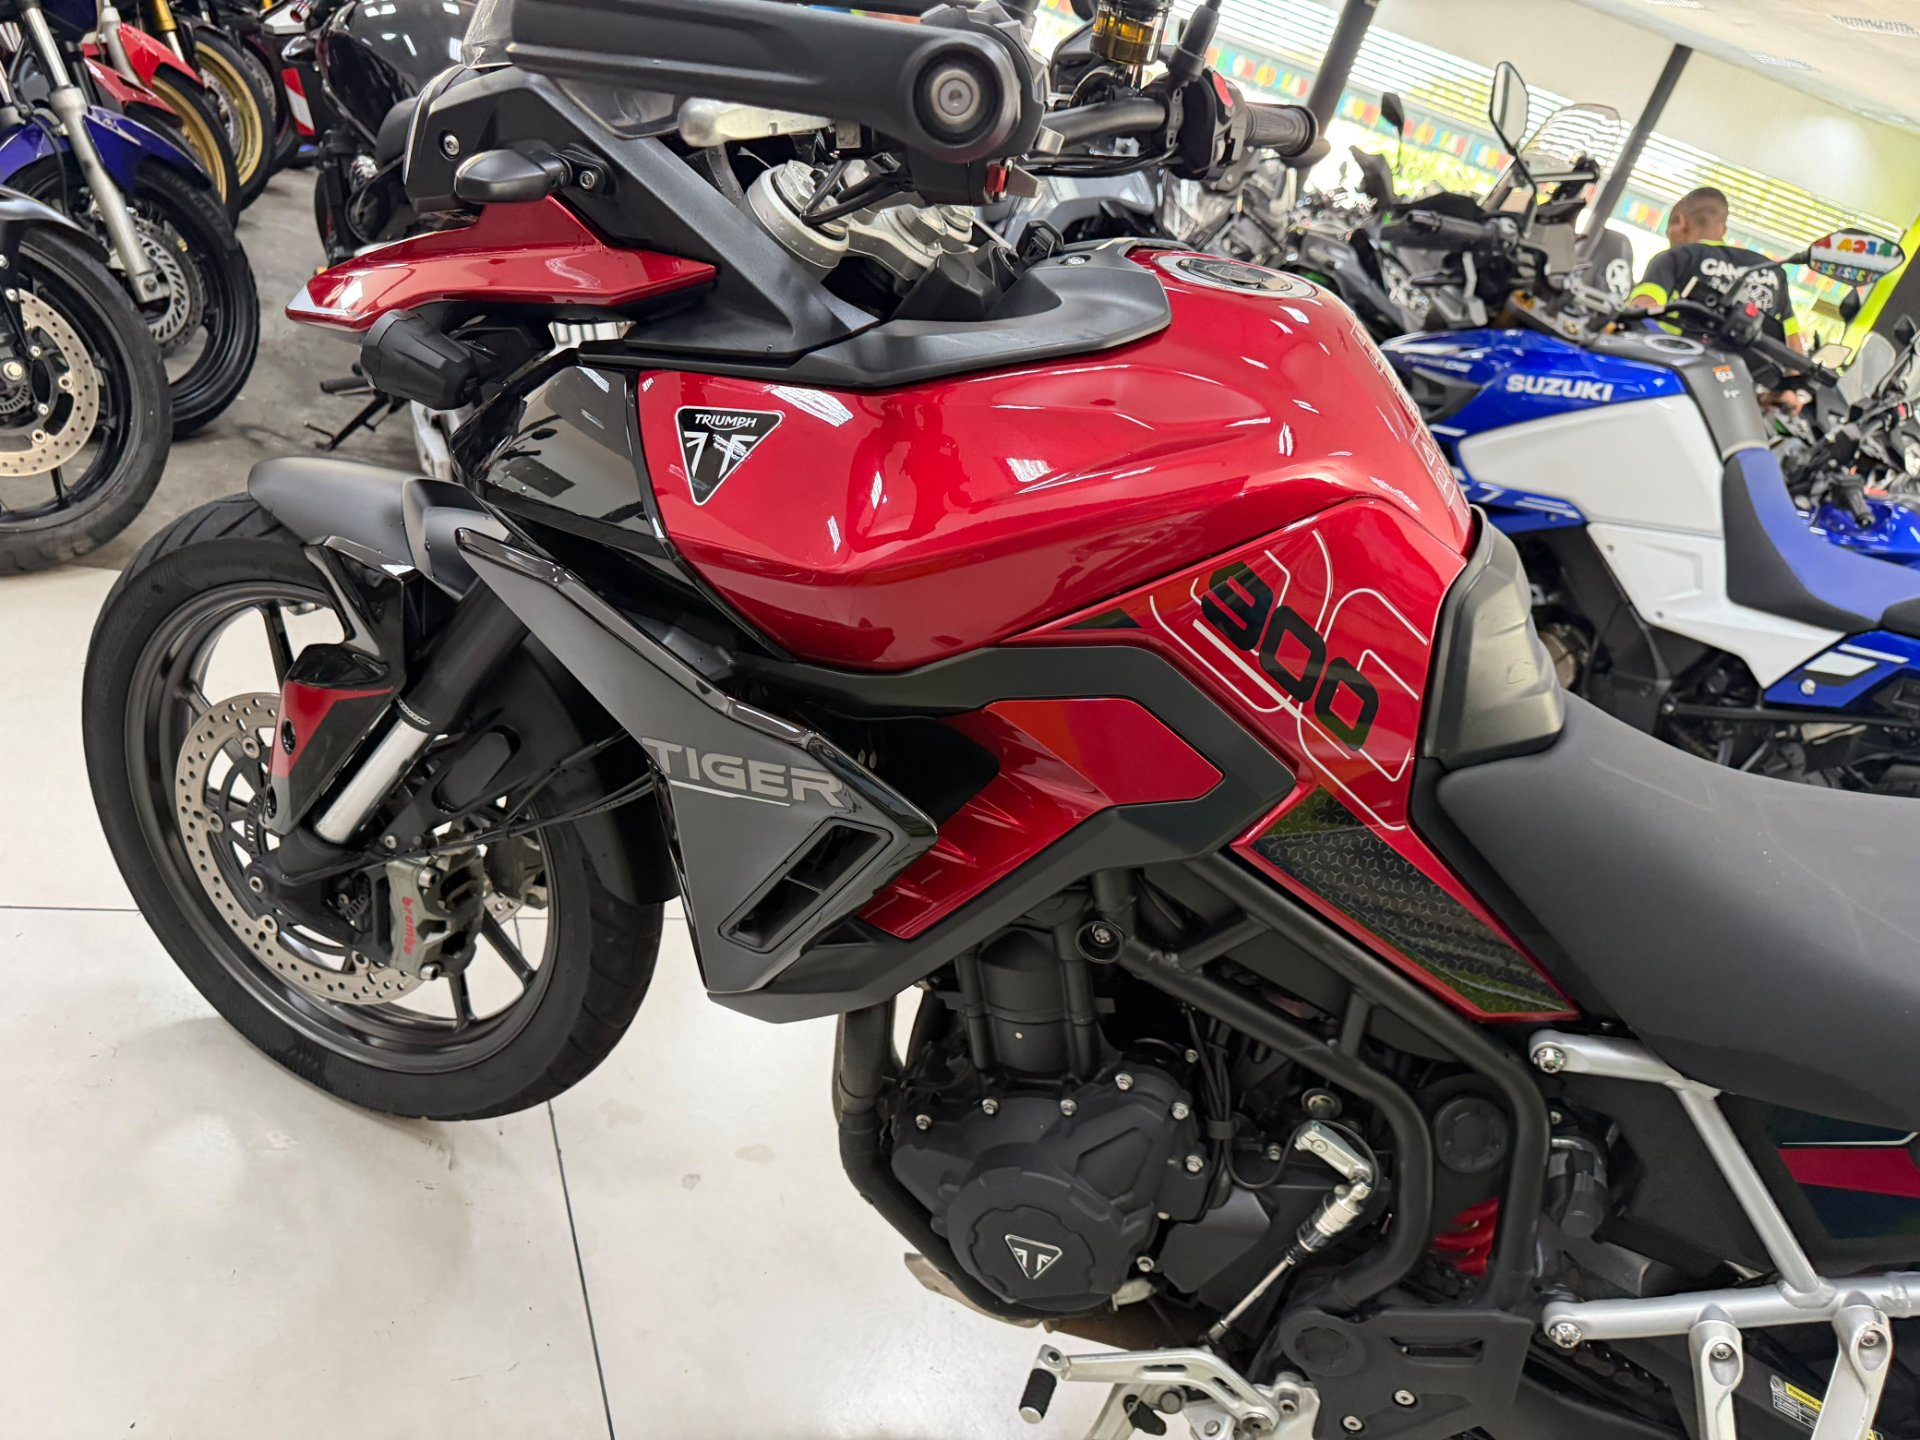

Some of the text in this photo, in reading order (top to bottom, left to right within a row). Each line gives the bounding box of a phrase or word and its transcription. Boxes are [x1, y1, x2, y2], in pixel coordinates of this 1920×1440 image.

[1506, 374, 1613, 402] SUZUKI
[695, 413, 758, 428] TRIUMPH
[1201, 560, 1379, 751] 900
[641, 736, 847, 809] TIGER
[402, 896, 418, 957] brembo
